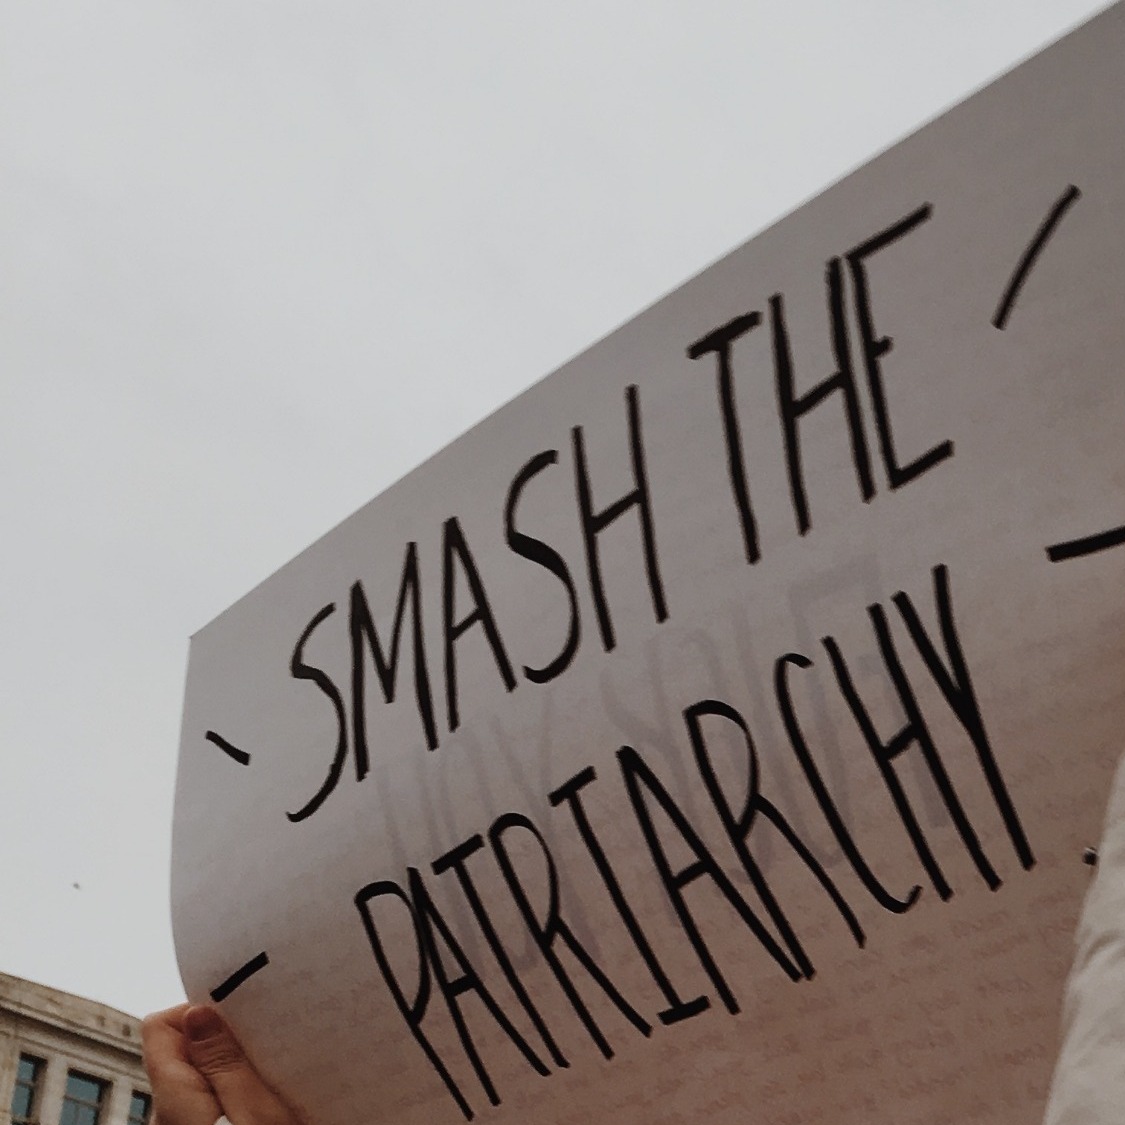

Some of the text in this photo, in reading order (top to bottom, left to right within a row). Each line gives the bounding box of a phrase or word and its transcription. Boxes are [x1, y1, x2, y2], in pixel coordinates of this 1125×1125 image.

[288, 206, 953, 822] SMASH THE
[354, 564, 1036, 1122] PATRIARCHY
